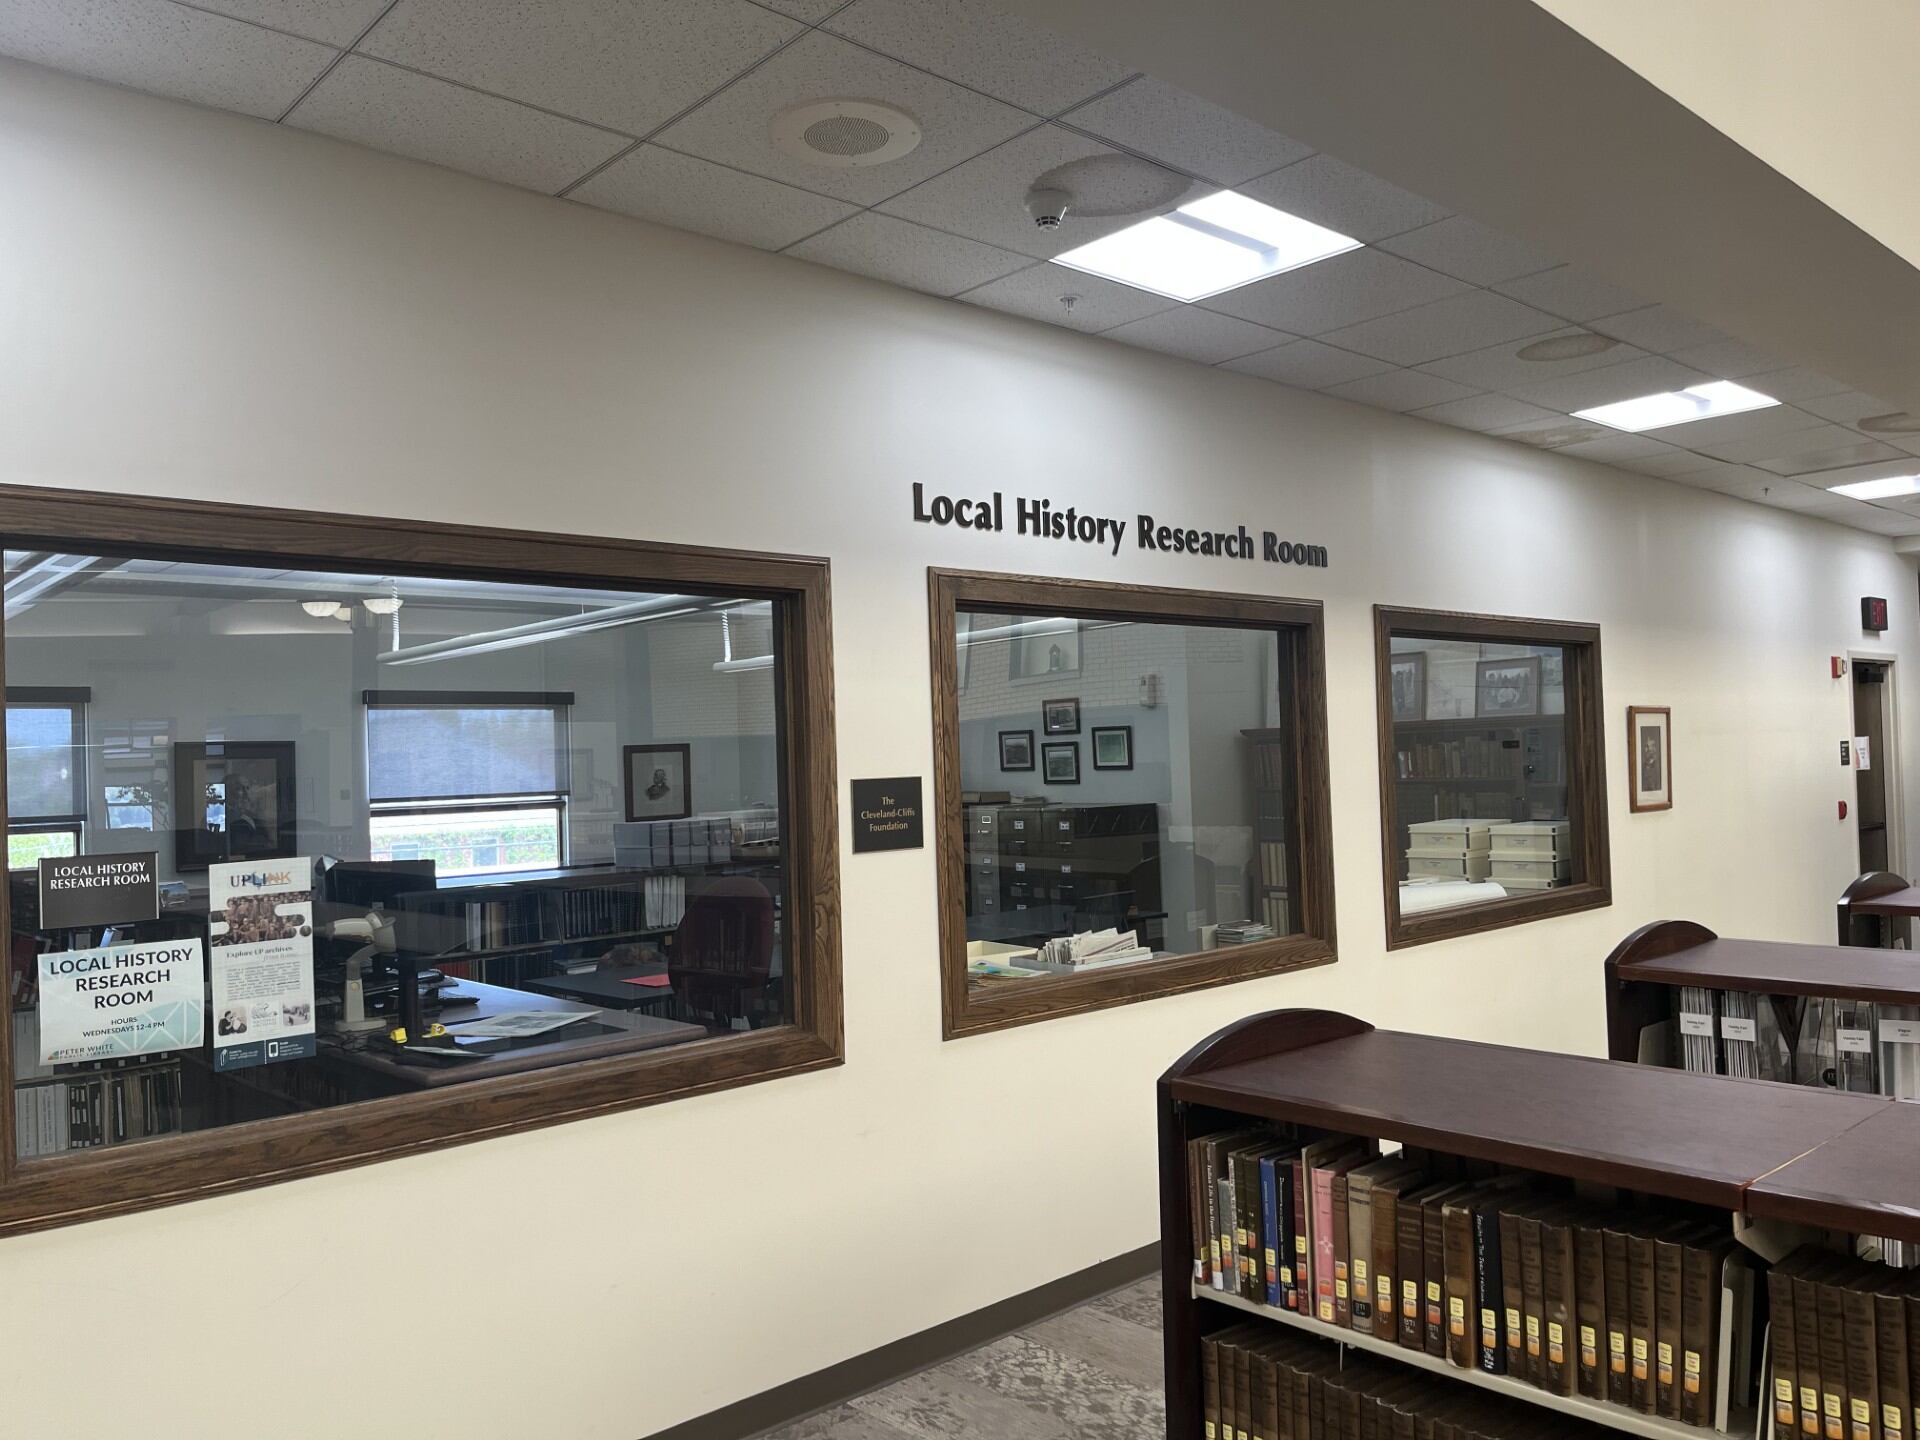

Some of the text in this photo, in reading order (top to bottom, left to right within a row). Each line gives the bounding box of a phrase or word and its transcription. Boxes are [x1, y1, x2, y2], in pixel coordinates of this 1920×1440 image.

[913, 482, 1328, 567] Local History Research Room
[881, 796, 895, 805] The
[861, 807, 915, 819] Cleveland-Cliffs
[869, 821, 908, 832] Foundation
[54, 861, 146, 877] LOCAL HISTORY
[50, 873, 151, 890] RESEARCH ROOM
[226, 950, 253, 958] Explore
[265, 946, 293, 954] archives
[50, 947, 193, 976] LOCAL HISTORY
[75, 968, 171, 992] RESEARCH
[94, 989, 153, 1009] ROOM
[111, 1017, 138, 1025] HOURS
[83, 1021, 165, 1038] WEDNESDAYS 12-4 PM
[59, 1043, 114, 1055] PETER WHITE
